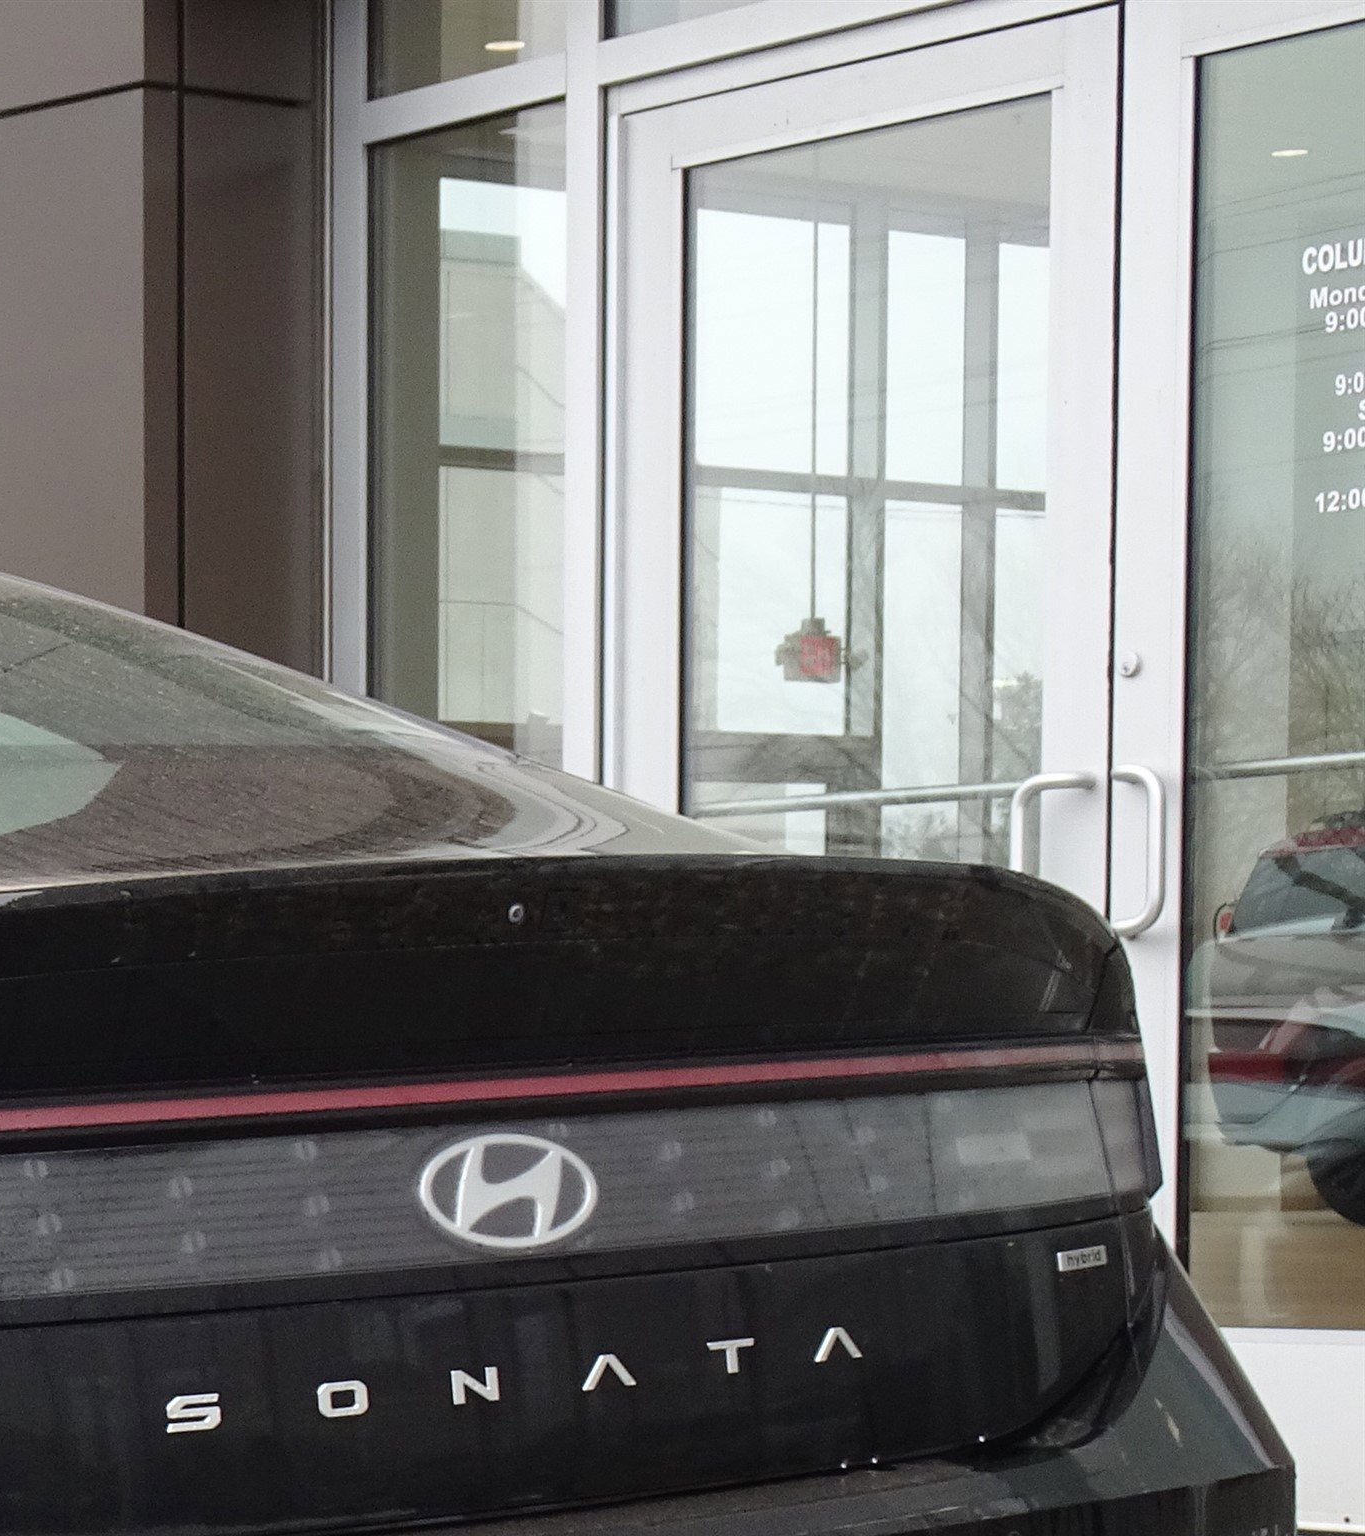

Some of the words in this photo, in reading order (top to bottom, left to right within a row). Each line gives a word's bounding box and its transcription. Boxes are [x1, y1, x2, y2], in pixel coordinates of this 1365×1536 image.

[1302, 238, 1365, 275] COLU
[1315, 488, 1365, 513] 12:0
[1066, 1248, 1102, 1268] hybrid
[165, 1327, 862, 1434] SONATA
